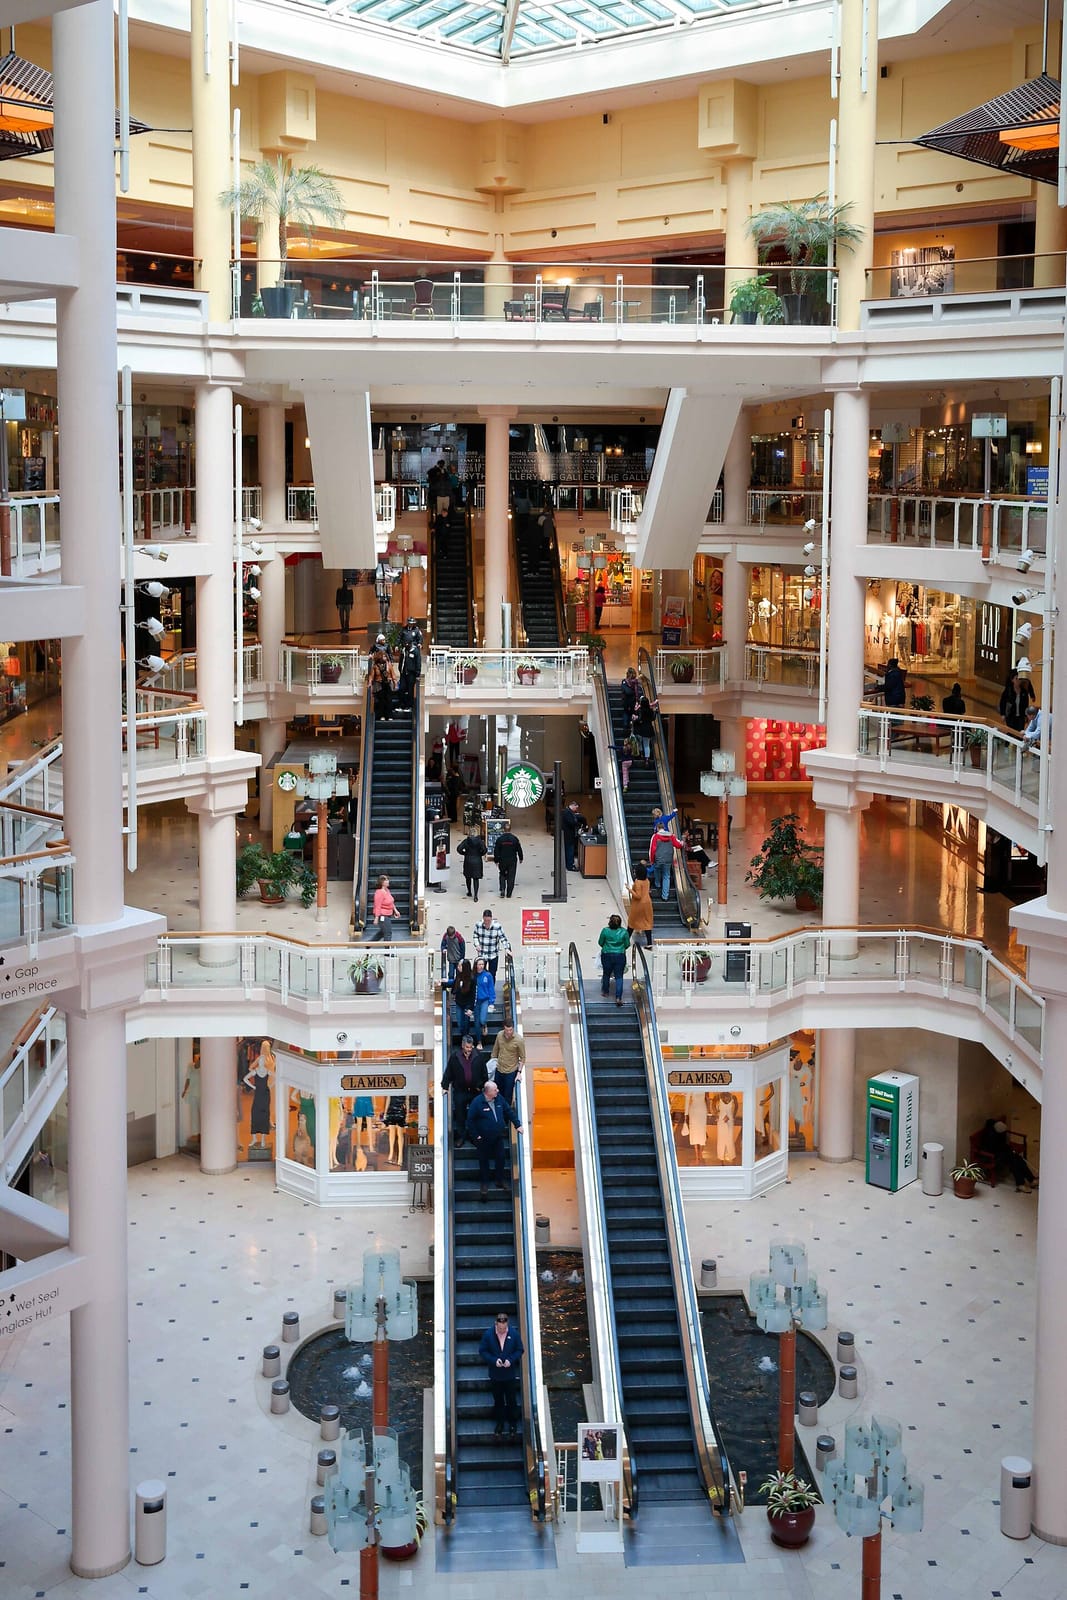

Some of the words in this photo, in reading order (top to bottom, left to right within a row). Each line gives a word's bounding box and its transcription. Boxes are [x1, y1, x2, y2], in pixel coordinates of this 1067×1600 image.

[982, 603, 1001, 649] GAP
[15, 966, 39, 979] Gap
[1, 986, 26, 1000] ren's
[28, 979, 58, 993] Place
[350, 1077, 365, 1088] LA
[367, 1076, 398, 1088] MESA
[678, 1072, 694, 1084] LA
[695, 1072, 725, 1084] MESA
[15, 1297, 35, 1312] Wet
[38, 1287, 60, 1304] Seal
[35, 1305, 52, 1320] Hut
